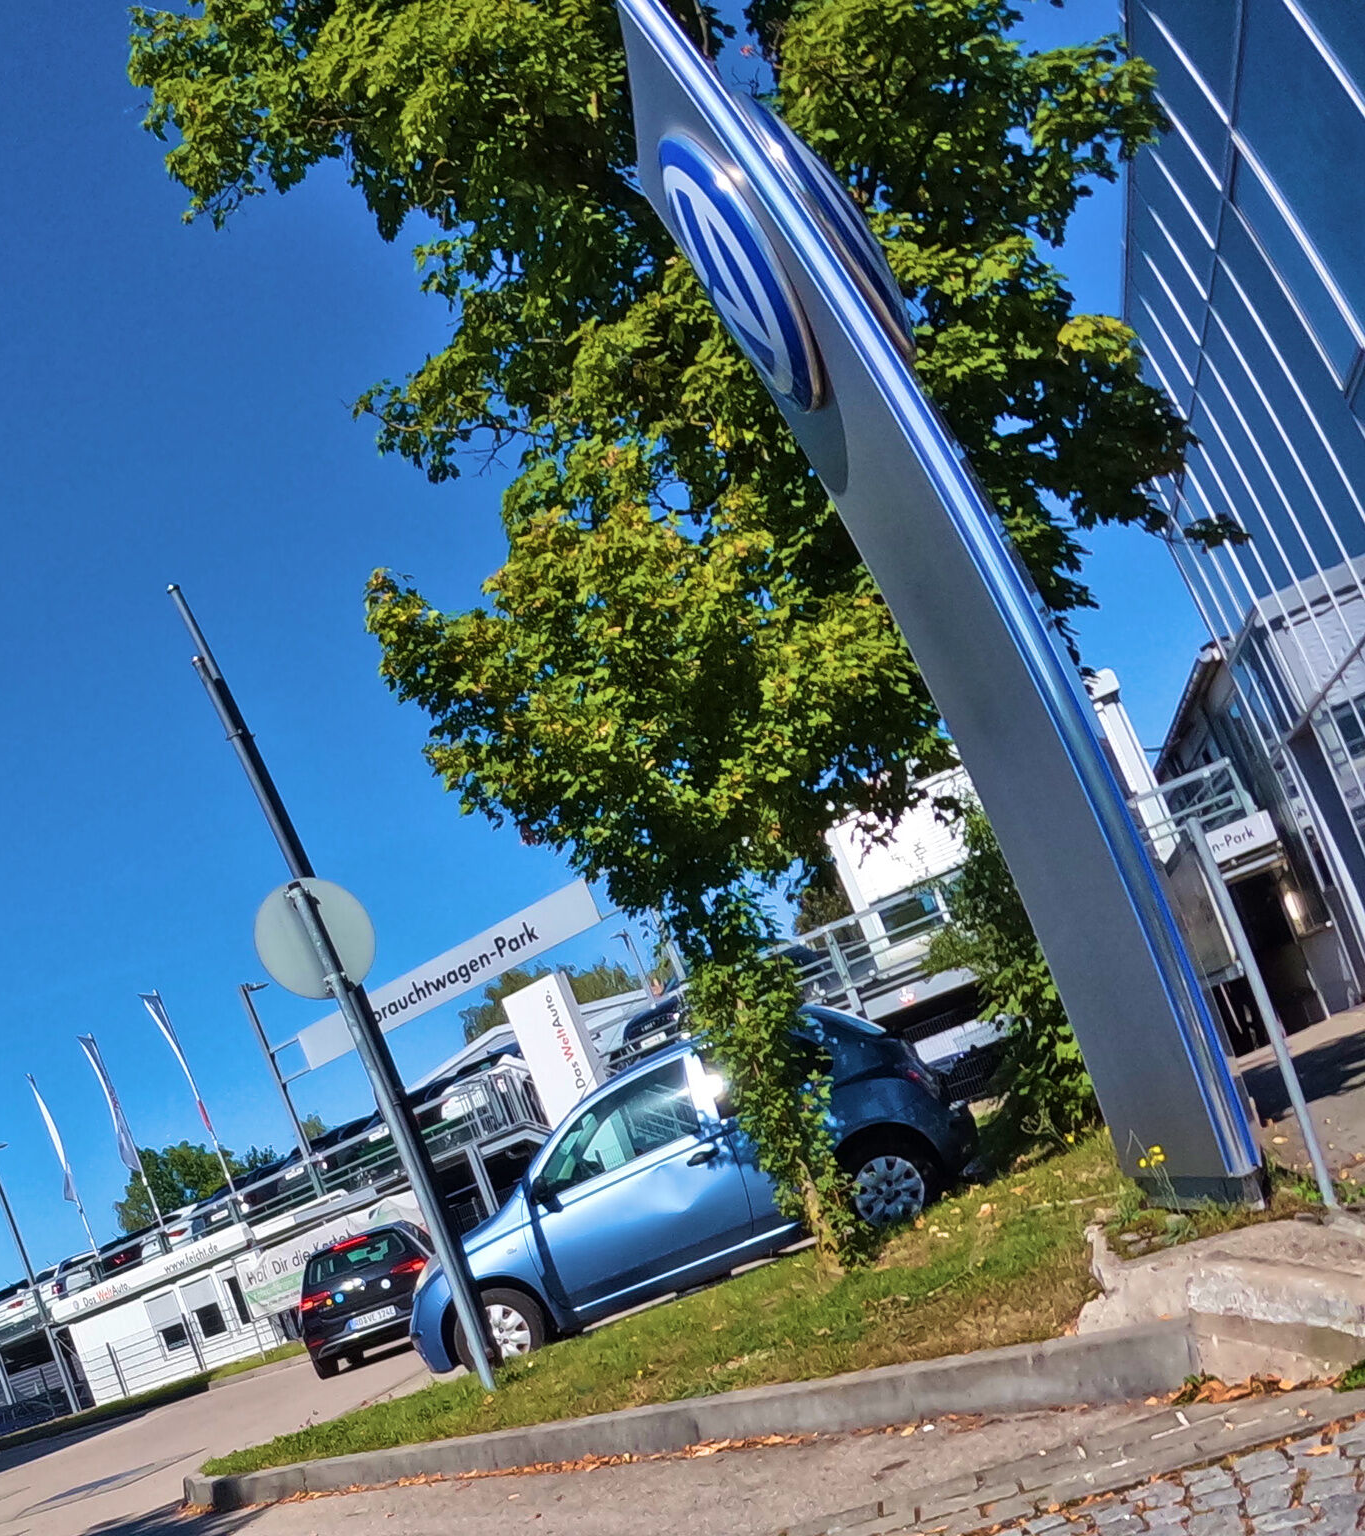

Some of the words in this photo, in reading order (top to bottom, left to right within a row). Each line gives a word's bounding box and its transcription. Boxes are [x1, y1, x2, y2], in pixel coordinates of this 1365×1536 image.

[1212, 826, 1255, 852] n-Park
[372, 921, 539, 1024] brauchtwagen-Park
[572, 1061, 586, 1089] Das
[164, 1243, 219, 1274] www.feicht.de
[272, 1259, 289, 1275] Dir
[293, 1249, 311, 1267] die
